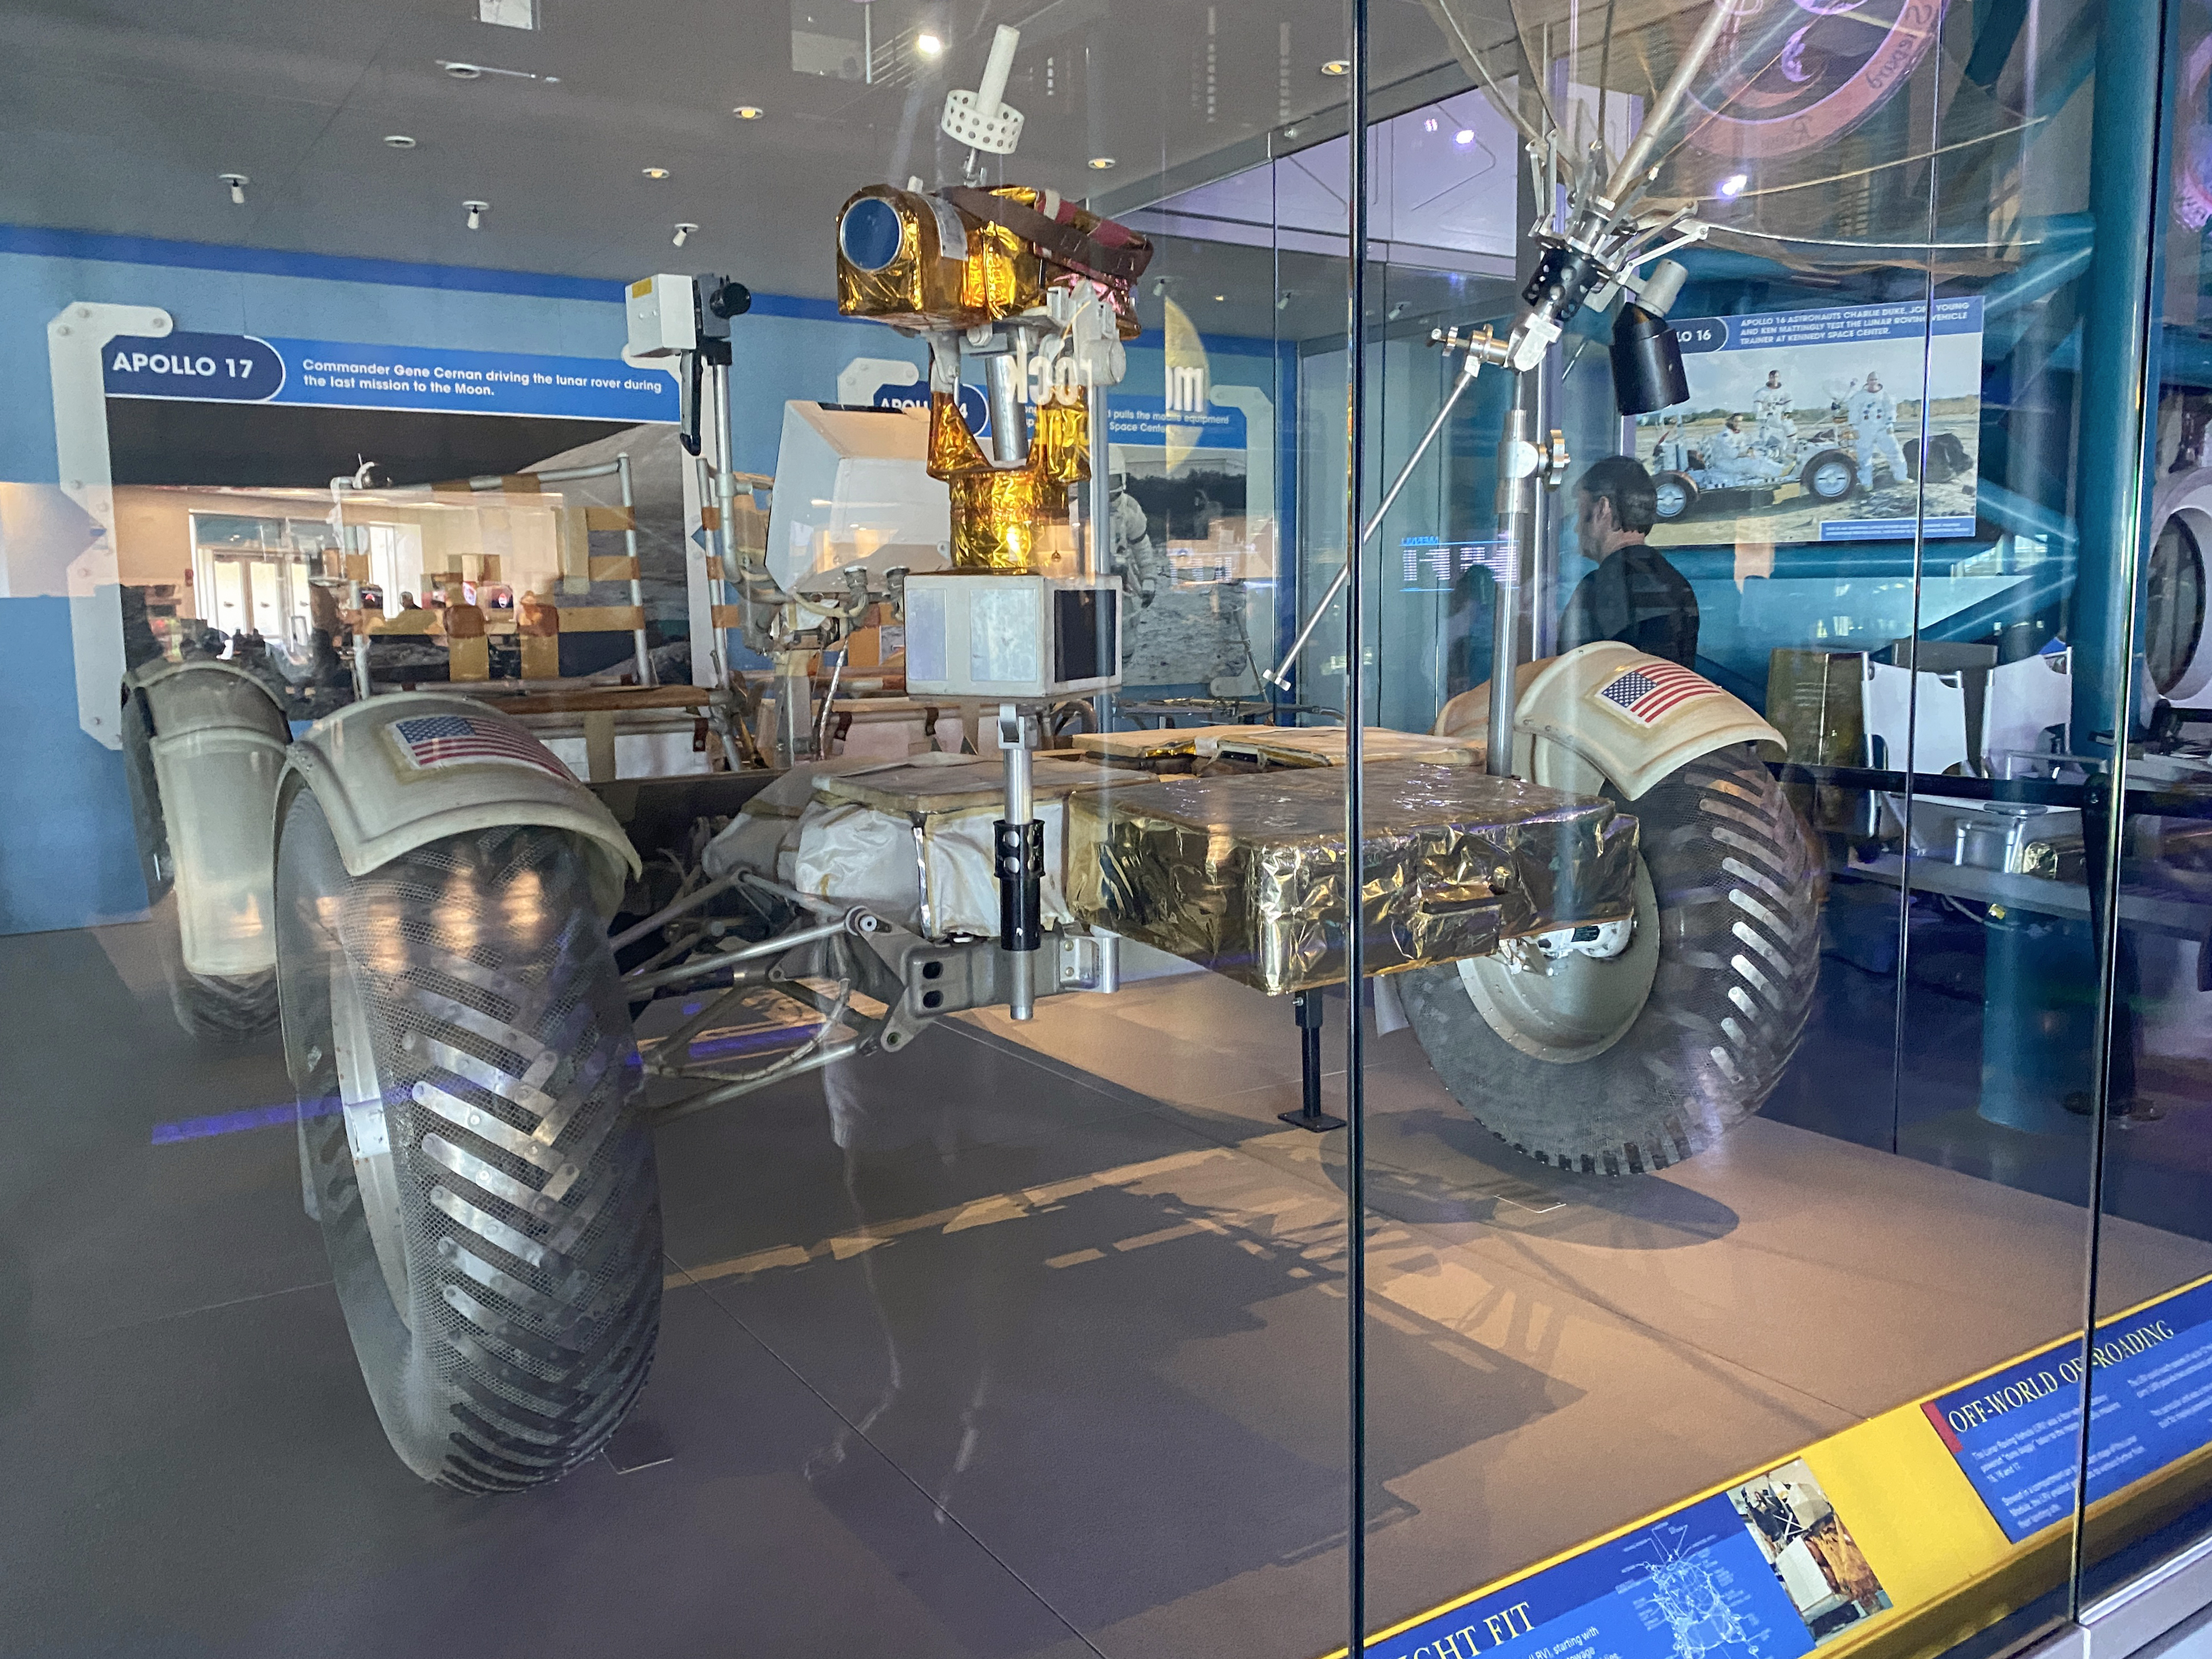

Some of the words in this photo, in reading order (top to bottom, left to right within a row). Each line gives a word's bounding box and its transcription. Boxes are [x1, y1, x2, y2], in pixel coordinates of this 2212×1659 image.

[1741, 318, 1772, 327] APOLLO
[1787, 312, 1841, 323] ASTRONAUTS
[1936, 302, 1969, 311] YOUNG
[1696, 330, 1711, 341] 16
[1740, 328, 1758, 336] AND
[1827, 321, 1845, 329] TEST
[1847, 319, 1861, 327] THE
[1863, 318, 1892, 327] LUNAR
[1828, 330, 1854, 339] SPACE
[113, 352, 216, 376] APOLLO
[225, 359, 253, 378] 17
[303, 359, 390, 375] Commander
[394, 365, 430, 377] Gene
[433, 367, 482, 381] Cernan
[486, 370, 530, 386] driving
[533, 373, 552, 385] the
[556, 374, 587, 387] lunar
[591, 378, 621, 389] rover
[624, 378, 662, 394] during
[303, 375, 326, 387] the
[330, 376, 355, 388] last
[359, 377, 409, 391] mission
[414, 381, 427, 392] to
[430, 381, 451, 394] the
[455, 383, 494, 395] Moon.
[1114, 410, 1134, 420] pulls
[1109, 421, 1138, 432] Space
[1948, 1372, 2058, 1432] OFF-WORLD
[1483, 1601, 1535, 1646] FIT
[1553, 1635, 1583, 1655] starting
[1581, 1626, 1600, 1641] with
